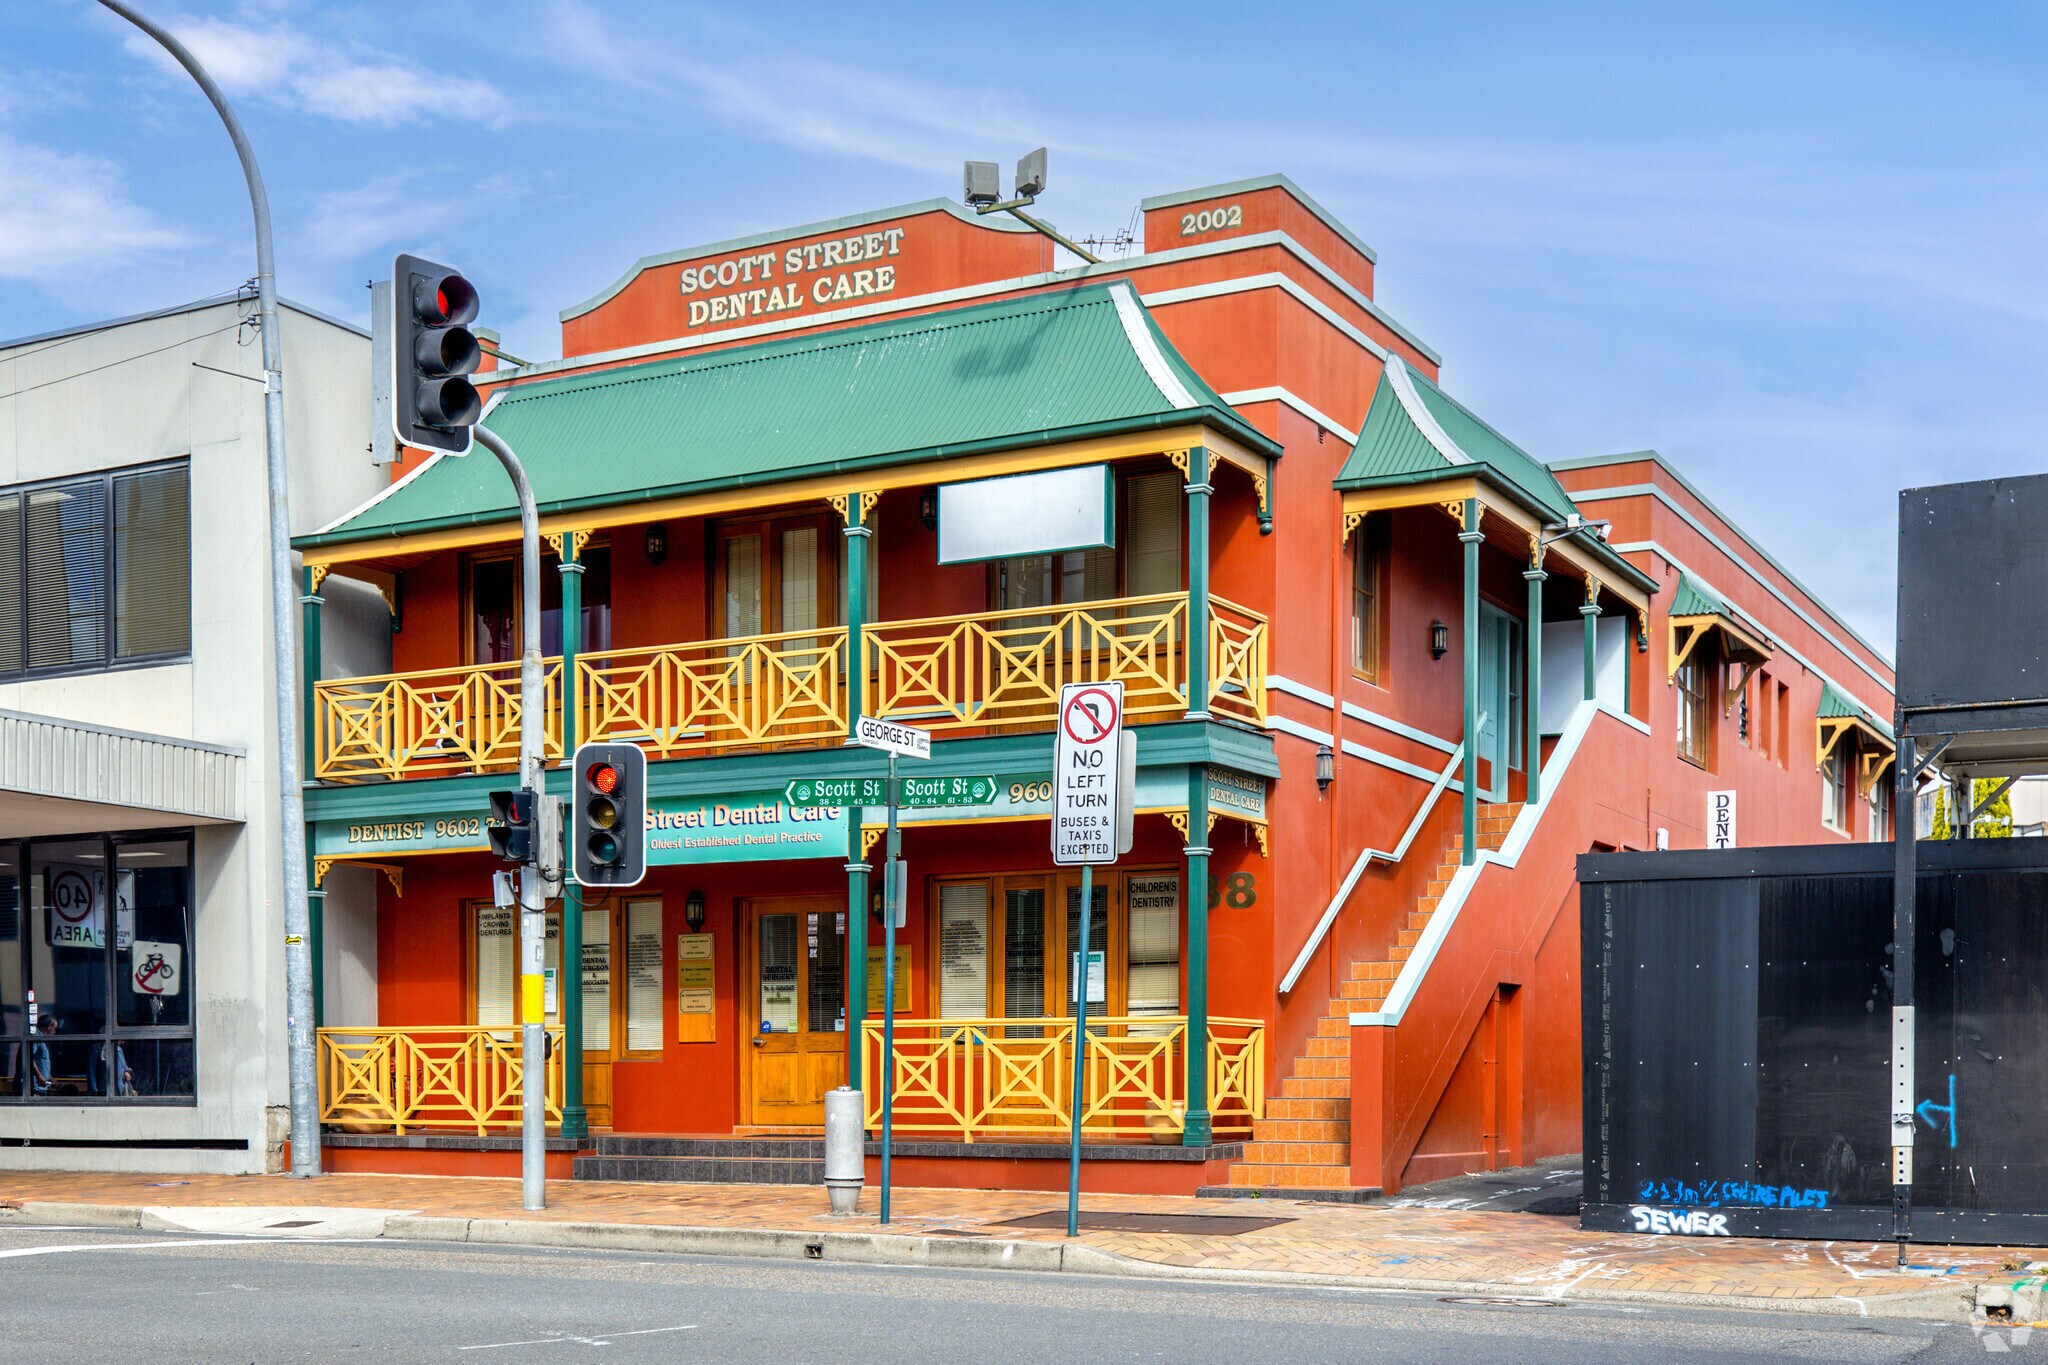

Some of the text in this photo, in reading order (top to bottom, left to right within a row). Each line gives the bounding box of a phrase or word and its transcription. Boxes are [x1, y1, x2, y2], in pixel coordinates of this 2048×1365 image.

[1180, 205, 1242, 237] 2002
[681, 227, 905, 294] SCOTT STREET
[688, 265, 896, 327] DENTAL CARE
[862, 721, 916, 747] GEORGE ST
[1073, 749, 1103, 768] NO
[815, 780, 880, 797] Scott St
[905, 778, 968, 796] Scott St
[1068, 774, 1106, 788] LEFT
[1208, 767, 1263, 794] SCOTT STREET
[1066, 794, 1107, 808] TURN
[1210, 787, 1260, 812] DENTAL CARE
[645, 800, 841, 831] Street Dental Care
[1061, 816, 1109, 828] BUSES &
[348, 820, 425, 843] DENTIST
[435, 817, 480, 838] 9602
[1069, 830, 1102, 841] TAXI'S
[650, 831, 822, 851] Oldest Established Dental Practice
[1061, 843, 1109, 855] EXCEPTED
[1131, 881, 1177, 894] CHILDREN'S
[1132, 896, 1175, 909] DENTISTRY
[482, 912, 511, 920] IMPLANTS
[483, 920, 510, 928] CROWNS
[480, 928, 512, 937] DENTURES
[762, 973, 795, 981] SURGERY
[1631, 1206, 1731, 1236] SEWER
